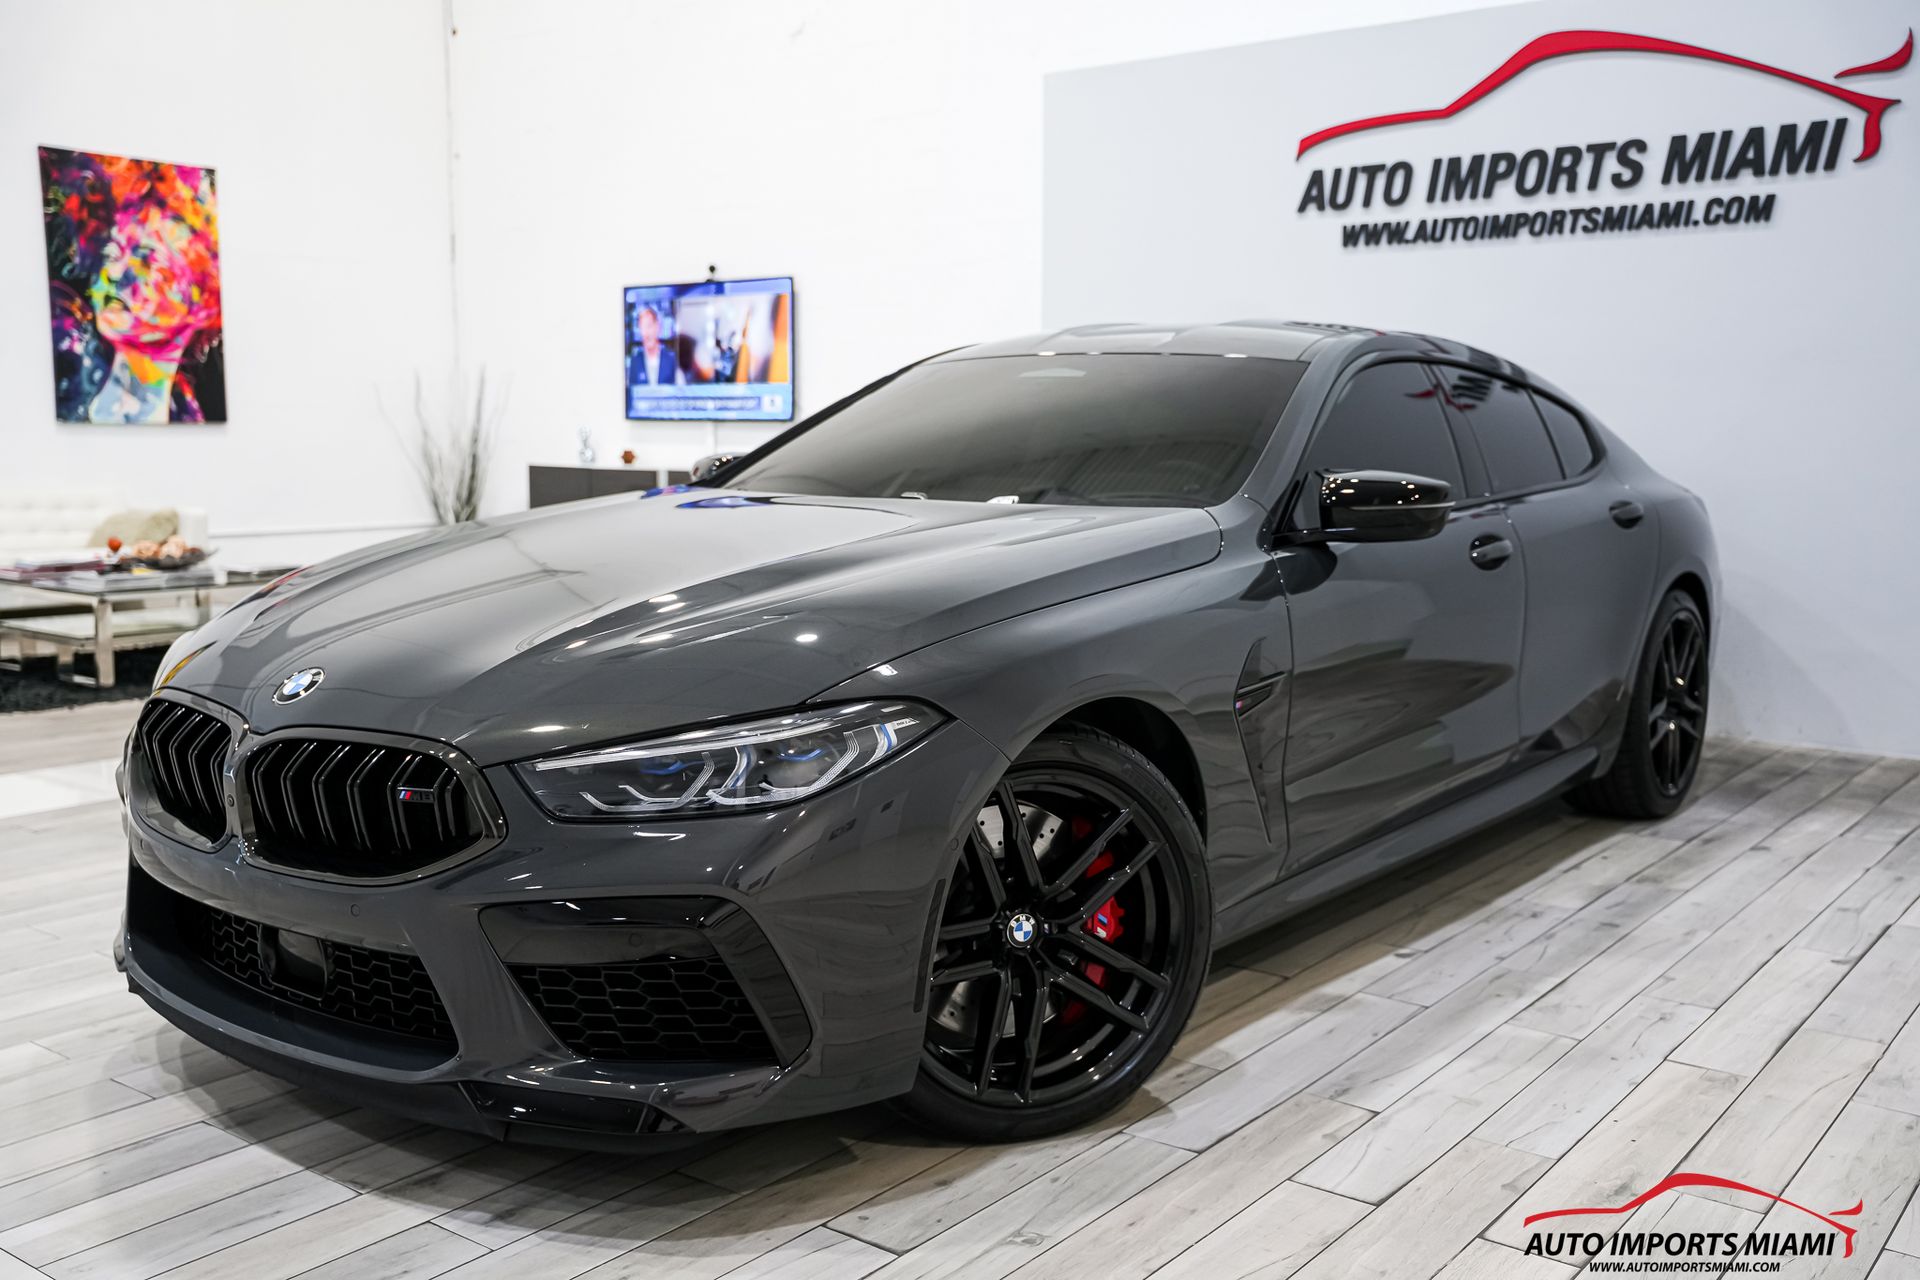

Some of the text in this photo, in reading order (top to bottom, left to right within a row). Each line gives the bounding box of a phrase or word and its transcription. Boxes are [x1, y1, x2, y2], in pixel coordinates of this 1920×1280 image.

[1297, 117, 1849, 213] AUTO IMPORTS MIAMI
[1342, 193, 1777, 248] WWW.AUTOIMPORTSMIAMI.COM
